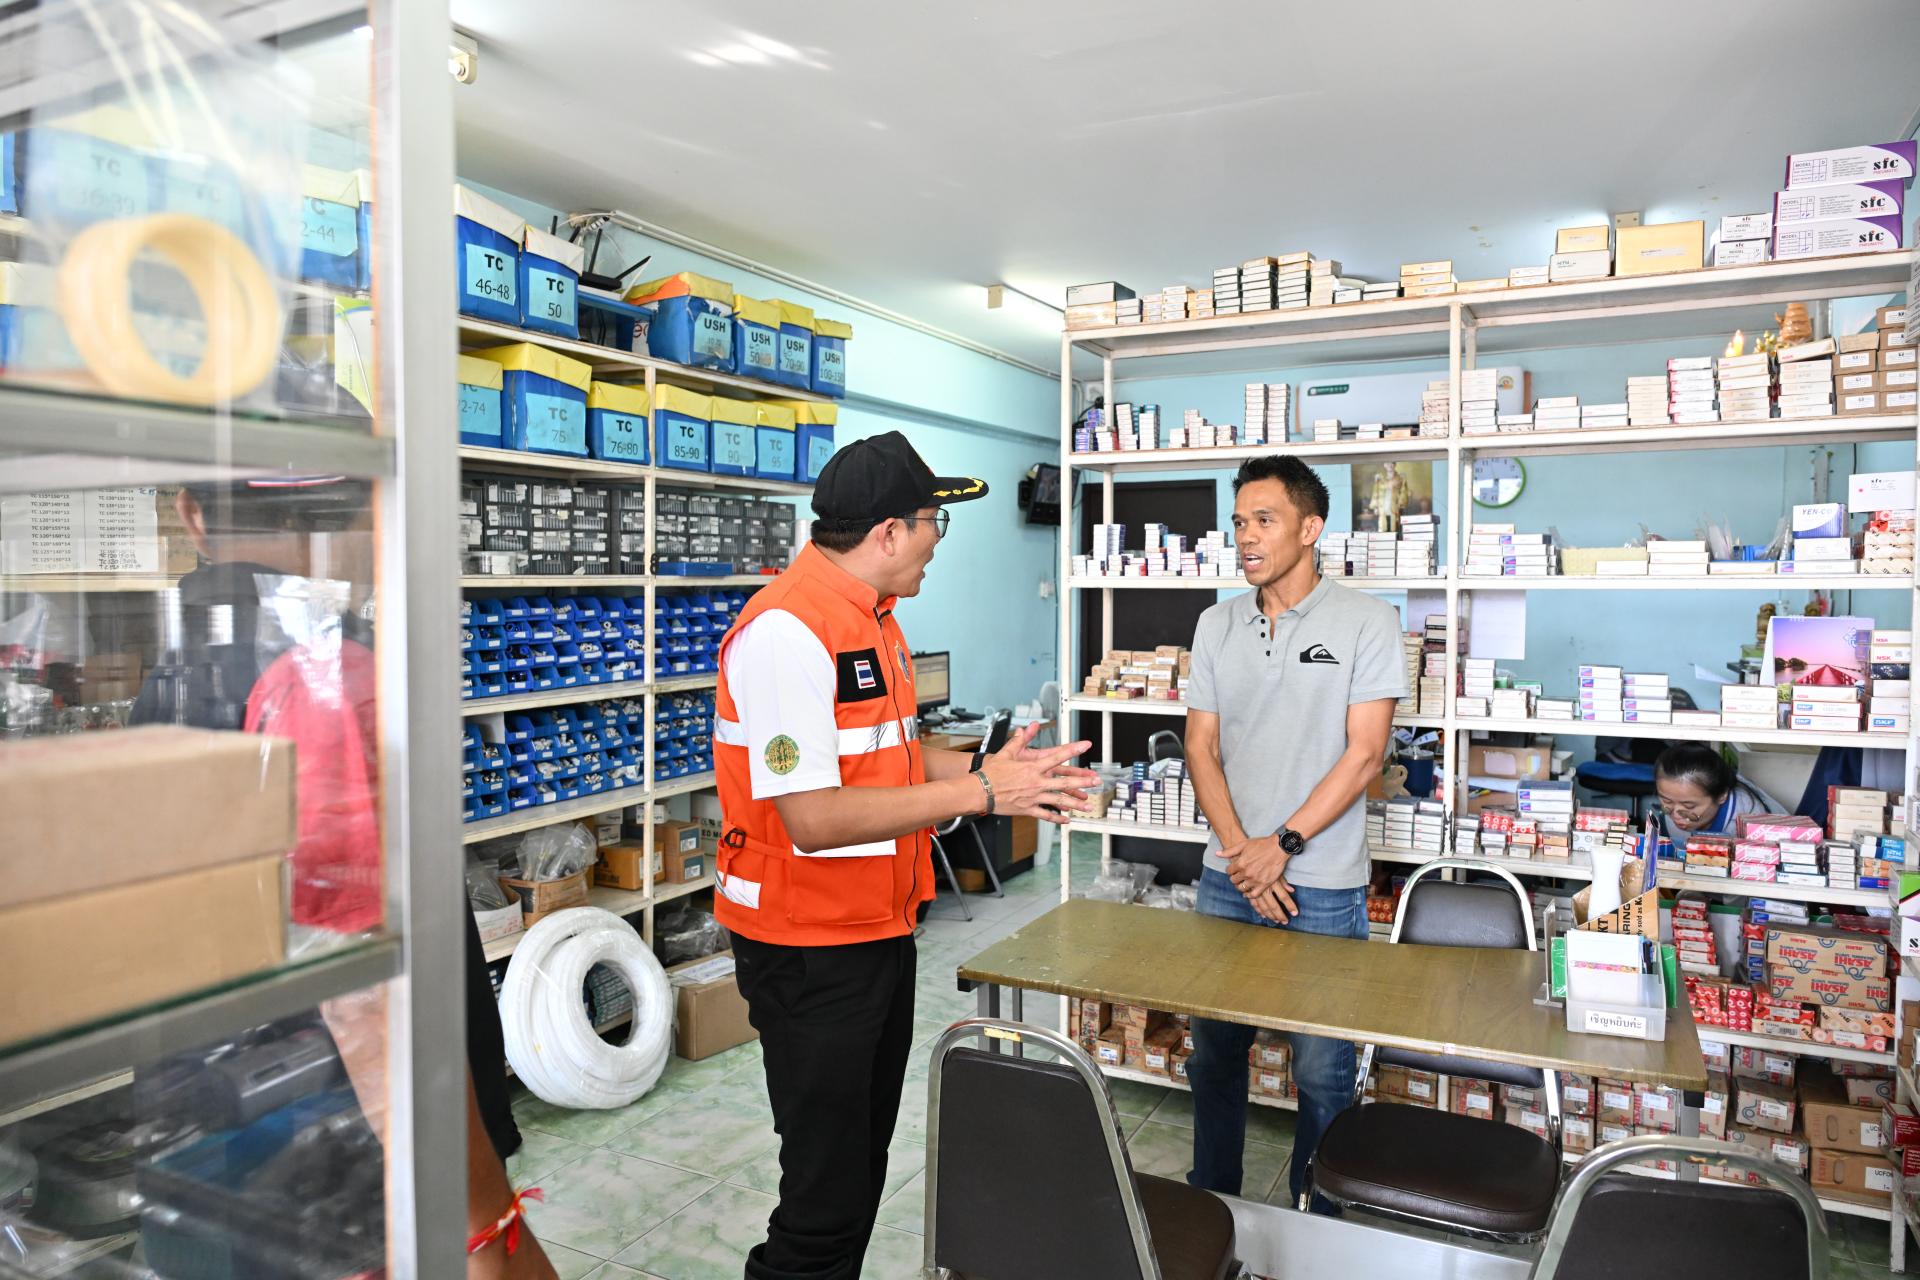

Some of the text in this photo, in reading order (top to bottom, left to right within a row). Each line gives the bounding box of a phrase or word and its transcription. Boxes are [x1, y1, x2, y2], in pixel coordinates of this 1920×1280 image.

[1873, 157, 1898, 170] sfc
[1860, 195, 1885, 208] sfc
[1859, 230, 1884, 243] sfc
[484, 253, 504, 272] TC
[475, 278, 510, 300] 46-48
[546, 277, 565, 294] TC
[547, 302, 562, 319] 50
[703, 317, 726, 333] USH
[751, 331, 771, 346] USH
[786, 338, 805, 353] USH
[824, 351, 841, 364] USH
[548, 407, 568, 422] TC
[616, 419, 633, 433] TC
[679, 425, 695, 439] TC
[551, 429, 567, 444] 75
[725, 432, 741, 446] TC
[610, 440, 639, 456] 76-80
[674, 445, 700, 460] 85-90
[769, 439, 783, 452] TC
[818, 446, 828, 457] TC
[1778, 948, 1817, 960] ASAHI
[1834, 955, 1873, 967] ASAHI
[1811, 981, 1849, 993] ASAHI
[1881, 1016, 1894, 1028] FAG
